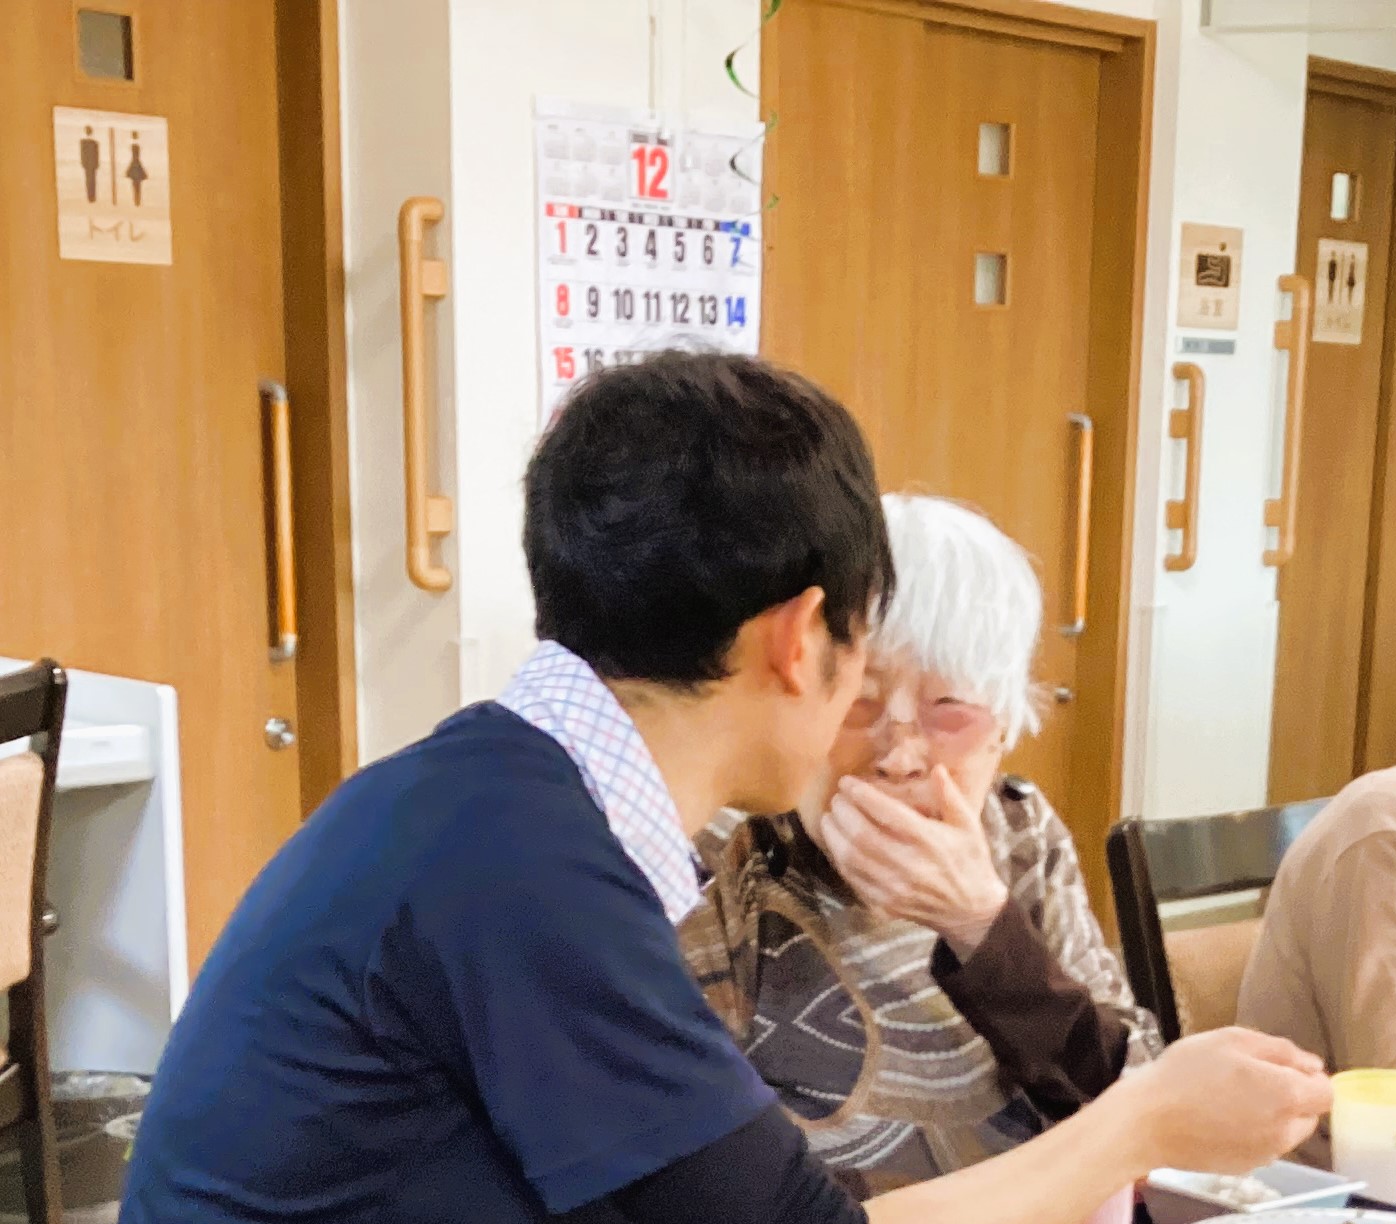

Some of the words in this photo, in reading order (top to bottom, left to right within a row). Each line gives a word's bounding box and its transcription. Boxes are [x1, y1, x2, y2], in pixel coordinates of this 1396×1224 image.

[631, 145, 669, 199] 12
[89, 217, 146, 242] トイレ
[556, 220, 566, 254] 1
[585, 223, 598, 255] 2
[616, 226, 627, 257] 3
[645, 229, 657, 260] 4
[674, 231, 685, 263] 5
[703, 234, 713, 265] 6
[730, 236, 742, 267] 7
[556, 283, 570, 316] 8
[587, 286, 599, 318] 9
[613, 288, 634, 320] 10
[643, 291, 661, 322] 11
[671, 292, 690, 324] 12
[699, 294, 718, 325] 13
[725, 295, 746, 327] 14
[553, 346, 575, 379] 15
